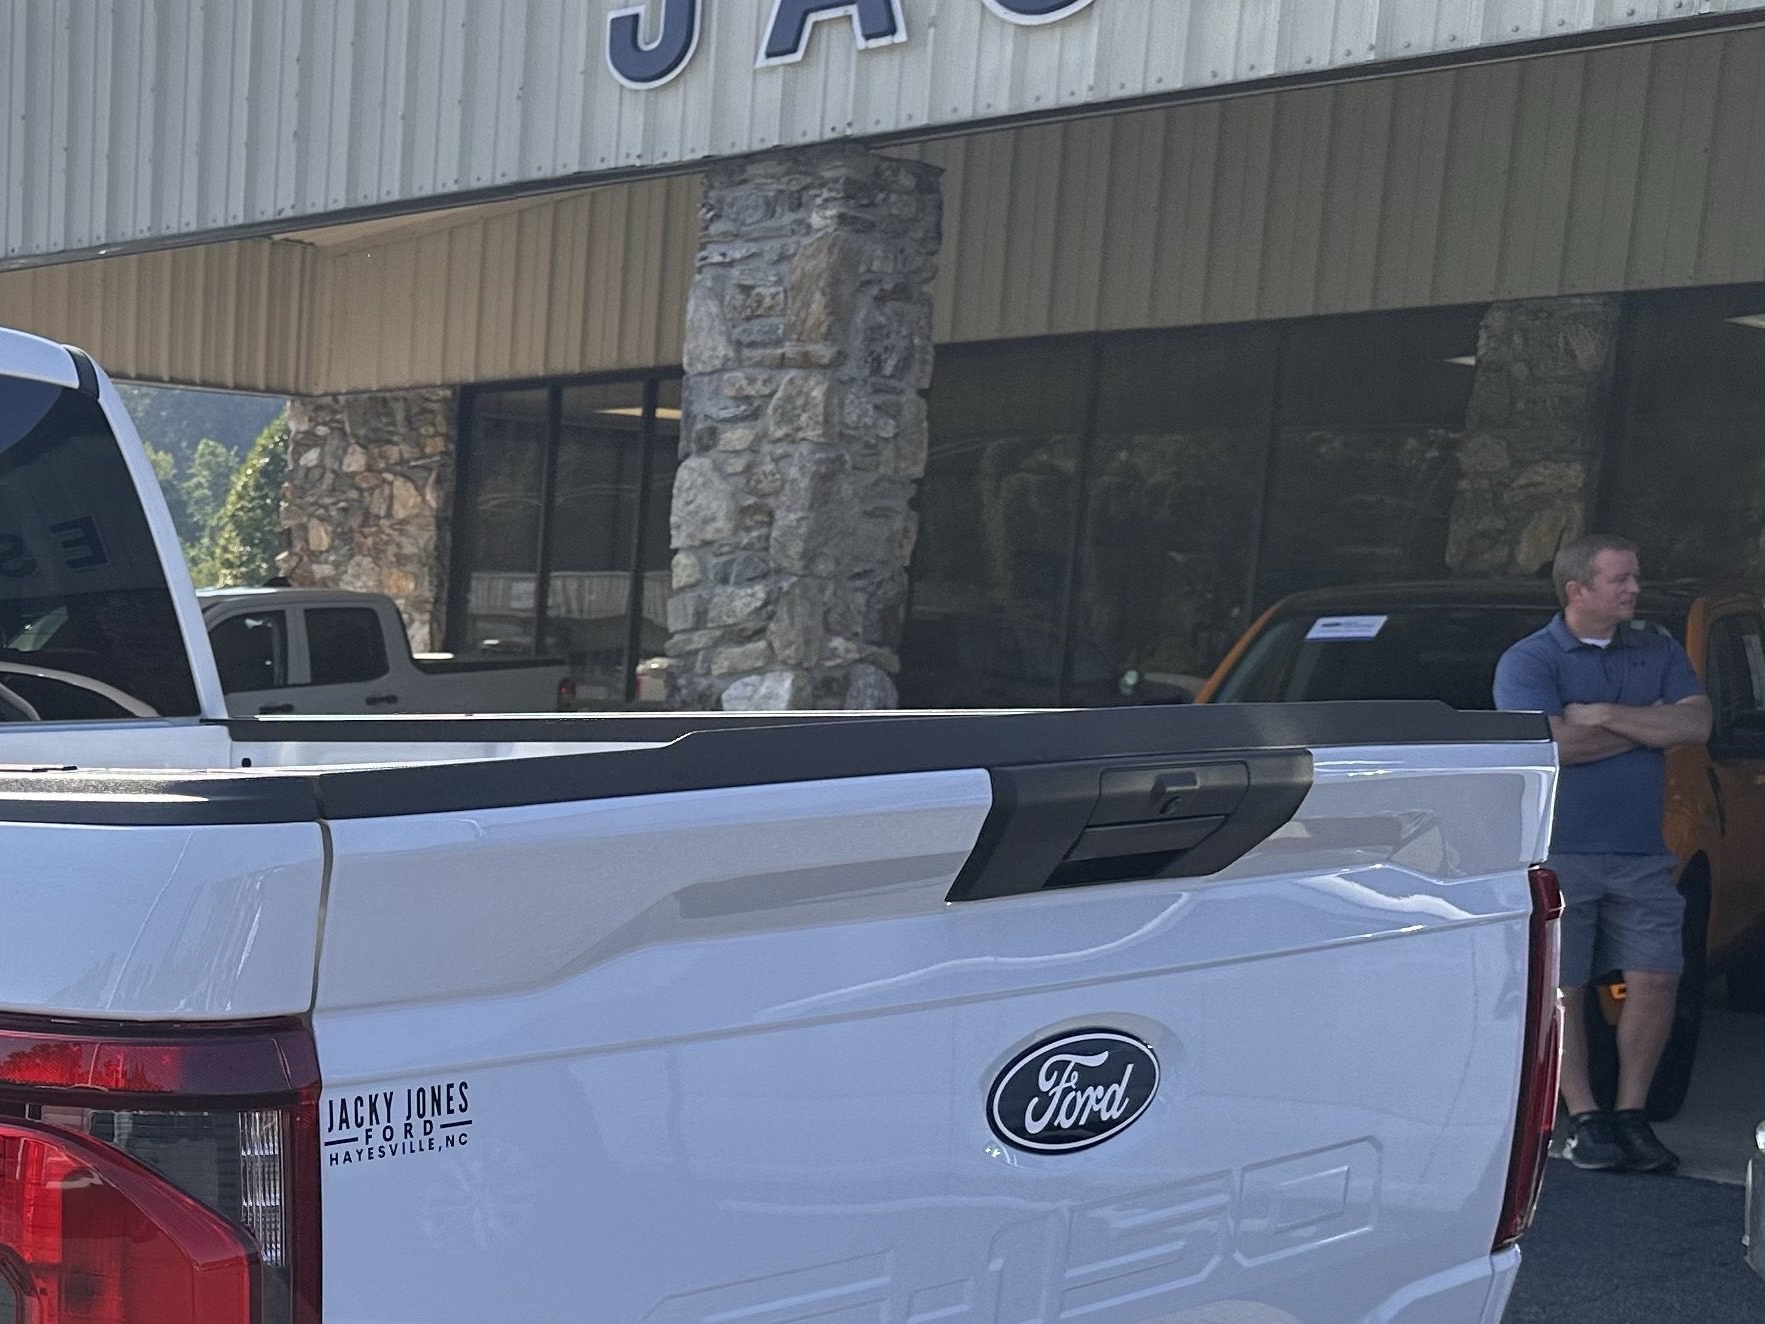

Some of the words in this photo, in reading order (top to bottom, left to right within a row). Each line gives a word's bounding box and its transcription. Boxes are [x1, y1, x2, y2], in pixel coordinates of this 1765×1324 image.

[327, 1090, 395, 1134] JACKY
[405, 1080, 470, 1122] JONES
[1025, 1050, 1134, 1134] Ford
[364, 1119, 435, 1146] FORD
